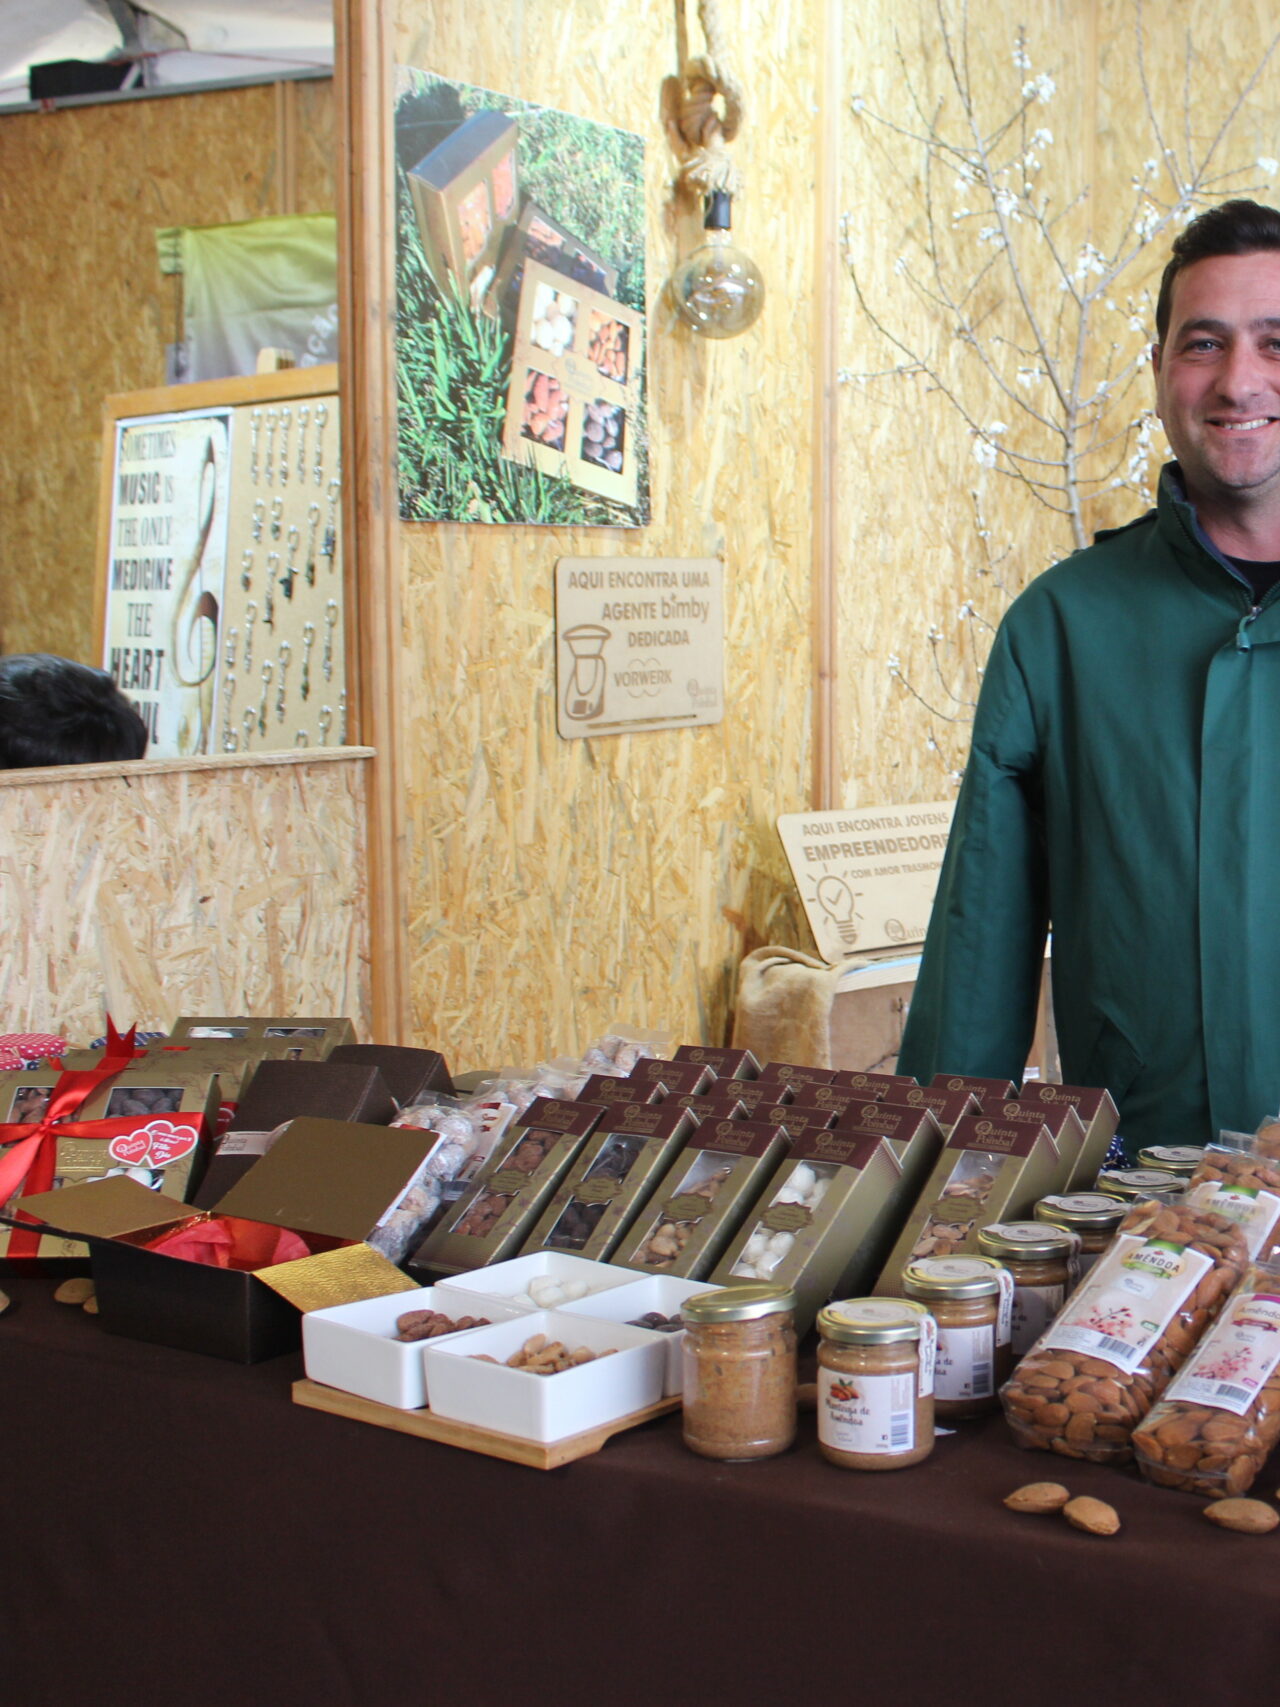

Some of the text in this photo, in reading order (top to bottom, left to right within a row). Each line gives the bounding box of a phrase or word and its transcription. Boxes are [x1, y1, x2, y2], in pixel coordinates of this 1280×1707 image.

[119, 471, 161, 505] MUSIC
[118, 517, 138, 547] THE
[112, 558, 173, 591] MEDICINE
[568, 571, 710, 590] AQUI ENCONTRA UMA
[127, 602, 153, 637] THE
[602, 602, 657, 620] AGENTE
[628, 630, 690, 648] DEDICADA
[111, 647, 165, 691] HEART
[614, 669, 672, 687] VORWERK
[802, 812, 950, 837] AQUI ENCONTRA JOVENS
[1128, 1253, 1180, 1273] AMÊNDOA
